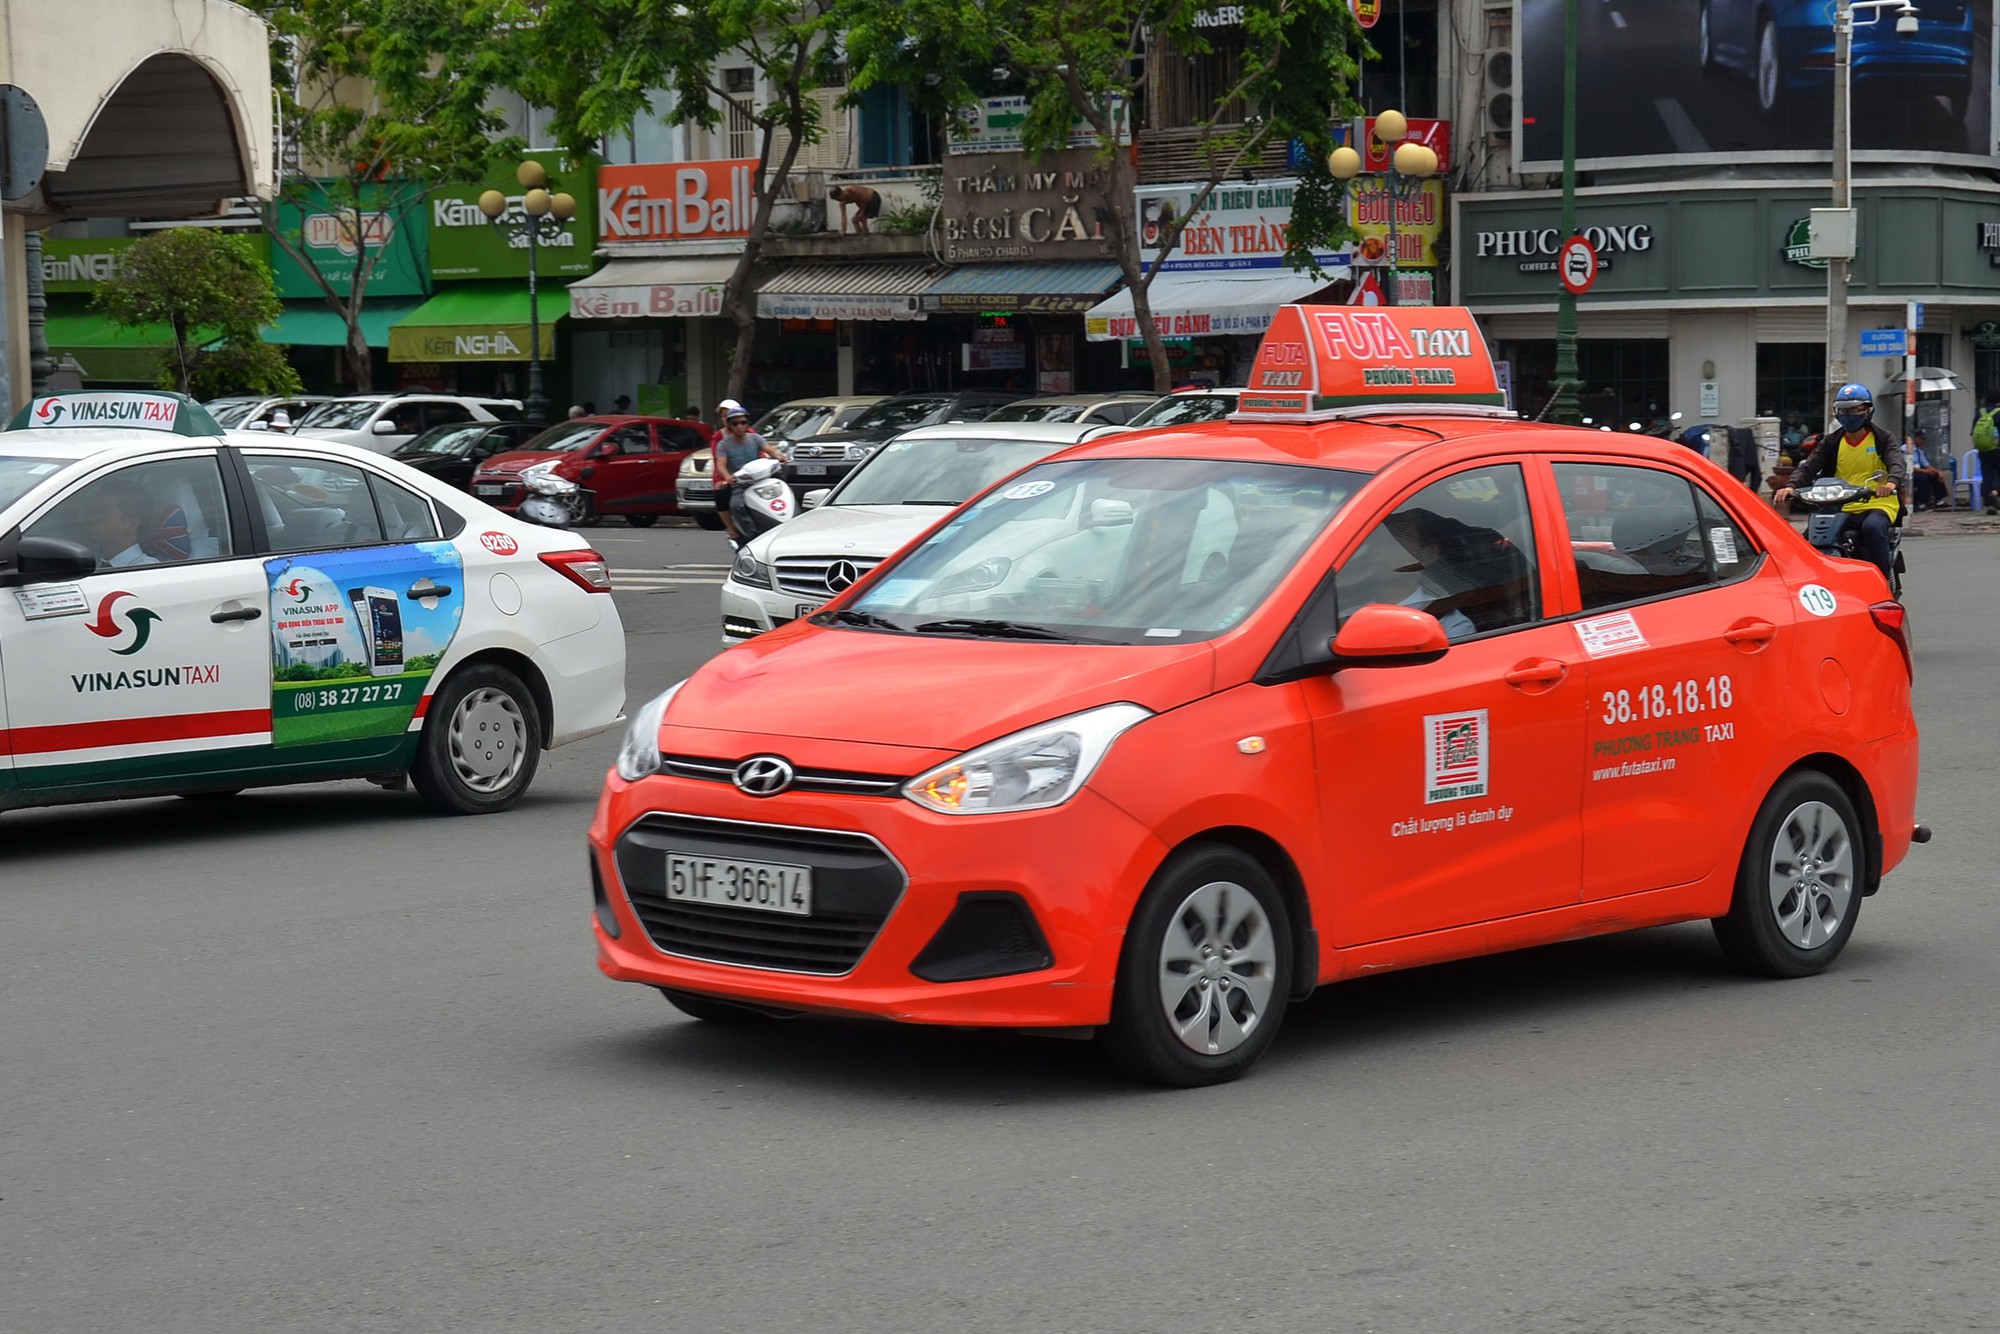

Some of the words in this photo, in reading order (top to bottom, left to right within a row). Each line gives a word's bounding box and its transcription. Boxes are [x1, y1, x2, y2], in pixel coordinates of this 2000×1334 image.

[1184, 213, 1225, 255] BẾN
[1229, 216, 1300, 255] THÀN
[1476, 228, 1559, 257] PHUC
[1574, 224, 1651, 253] ONG
[1314, 313, 1413, 360] FUTA
[1411, 329, 1472, 357] TAXI
[1262, 342, 1307, 365] FUTA
[1262, 370, 1303, 386] TAXI
[1414, 368, 1456, 387] TRANG
[71, 401, 144, 420] VINASUN
[143, 401, 177, 421] TAXI
[482, 533, 517, 555] 9269
[283, 605, 324, 616] VINASUN
[324, 604, 339, 613] APP
[1802, 588, 1834, 611] 119
[71, 667, 181, 693] VINASUN
[182, 664, 220, 685] TAXI
[295, 692, 316, 711] (08)
[319, 690, 338, 707] 38
[341, 688, 359, 704] 27
[362, 685, 380, 702] 27
[383, 683, 402, 699] 27
[1602, 675, 1733, 725] 38.18.18.18
[1655, 727, 1700, 748] TRANG
[1704, 722, 1735, 743] TAXI
[1592, 757, 1676, 781] www.futataxi.vn
[1391, 817, 1419, 837] Chất
[1420, 817, 1454, 834] lượng
[1456, 811, 1467, 827] là
[1468, 807, 1496, 824] danh
[1497, 805, 1514, 822] dự
